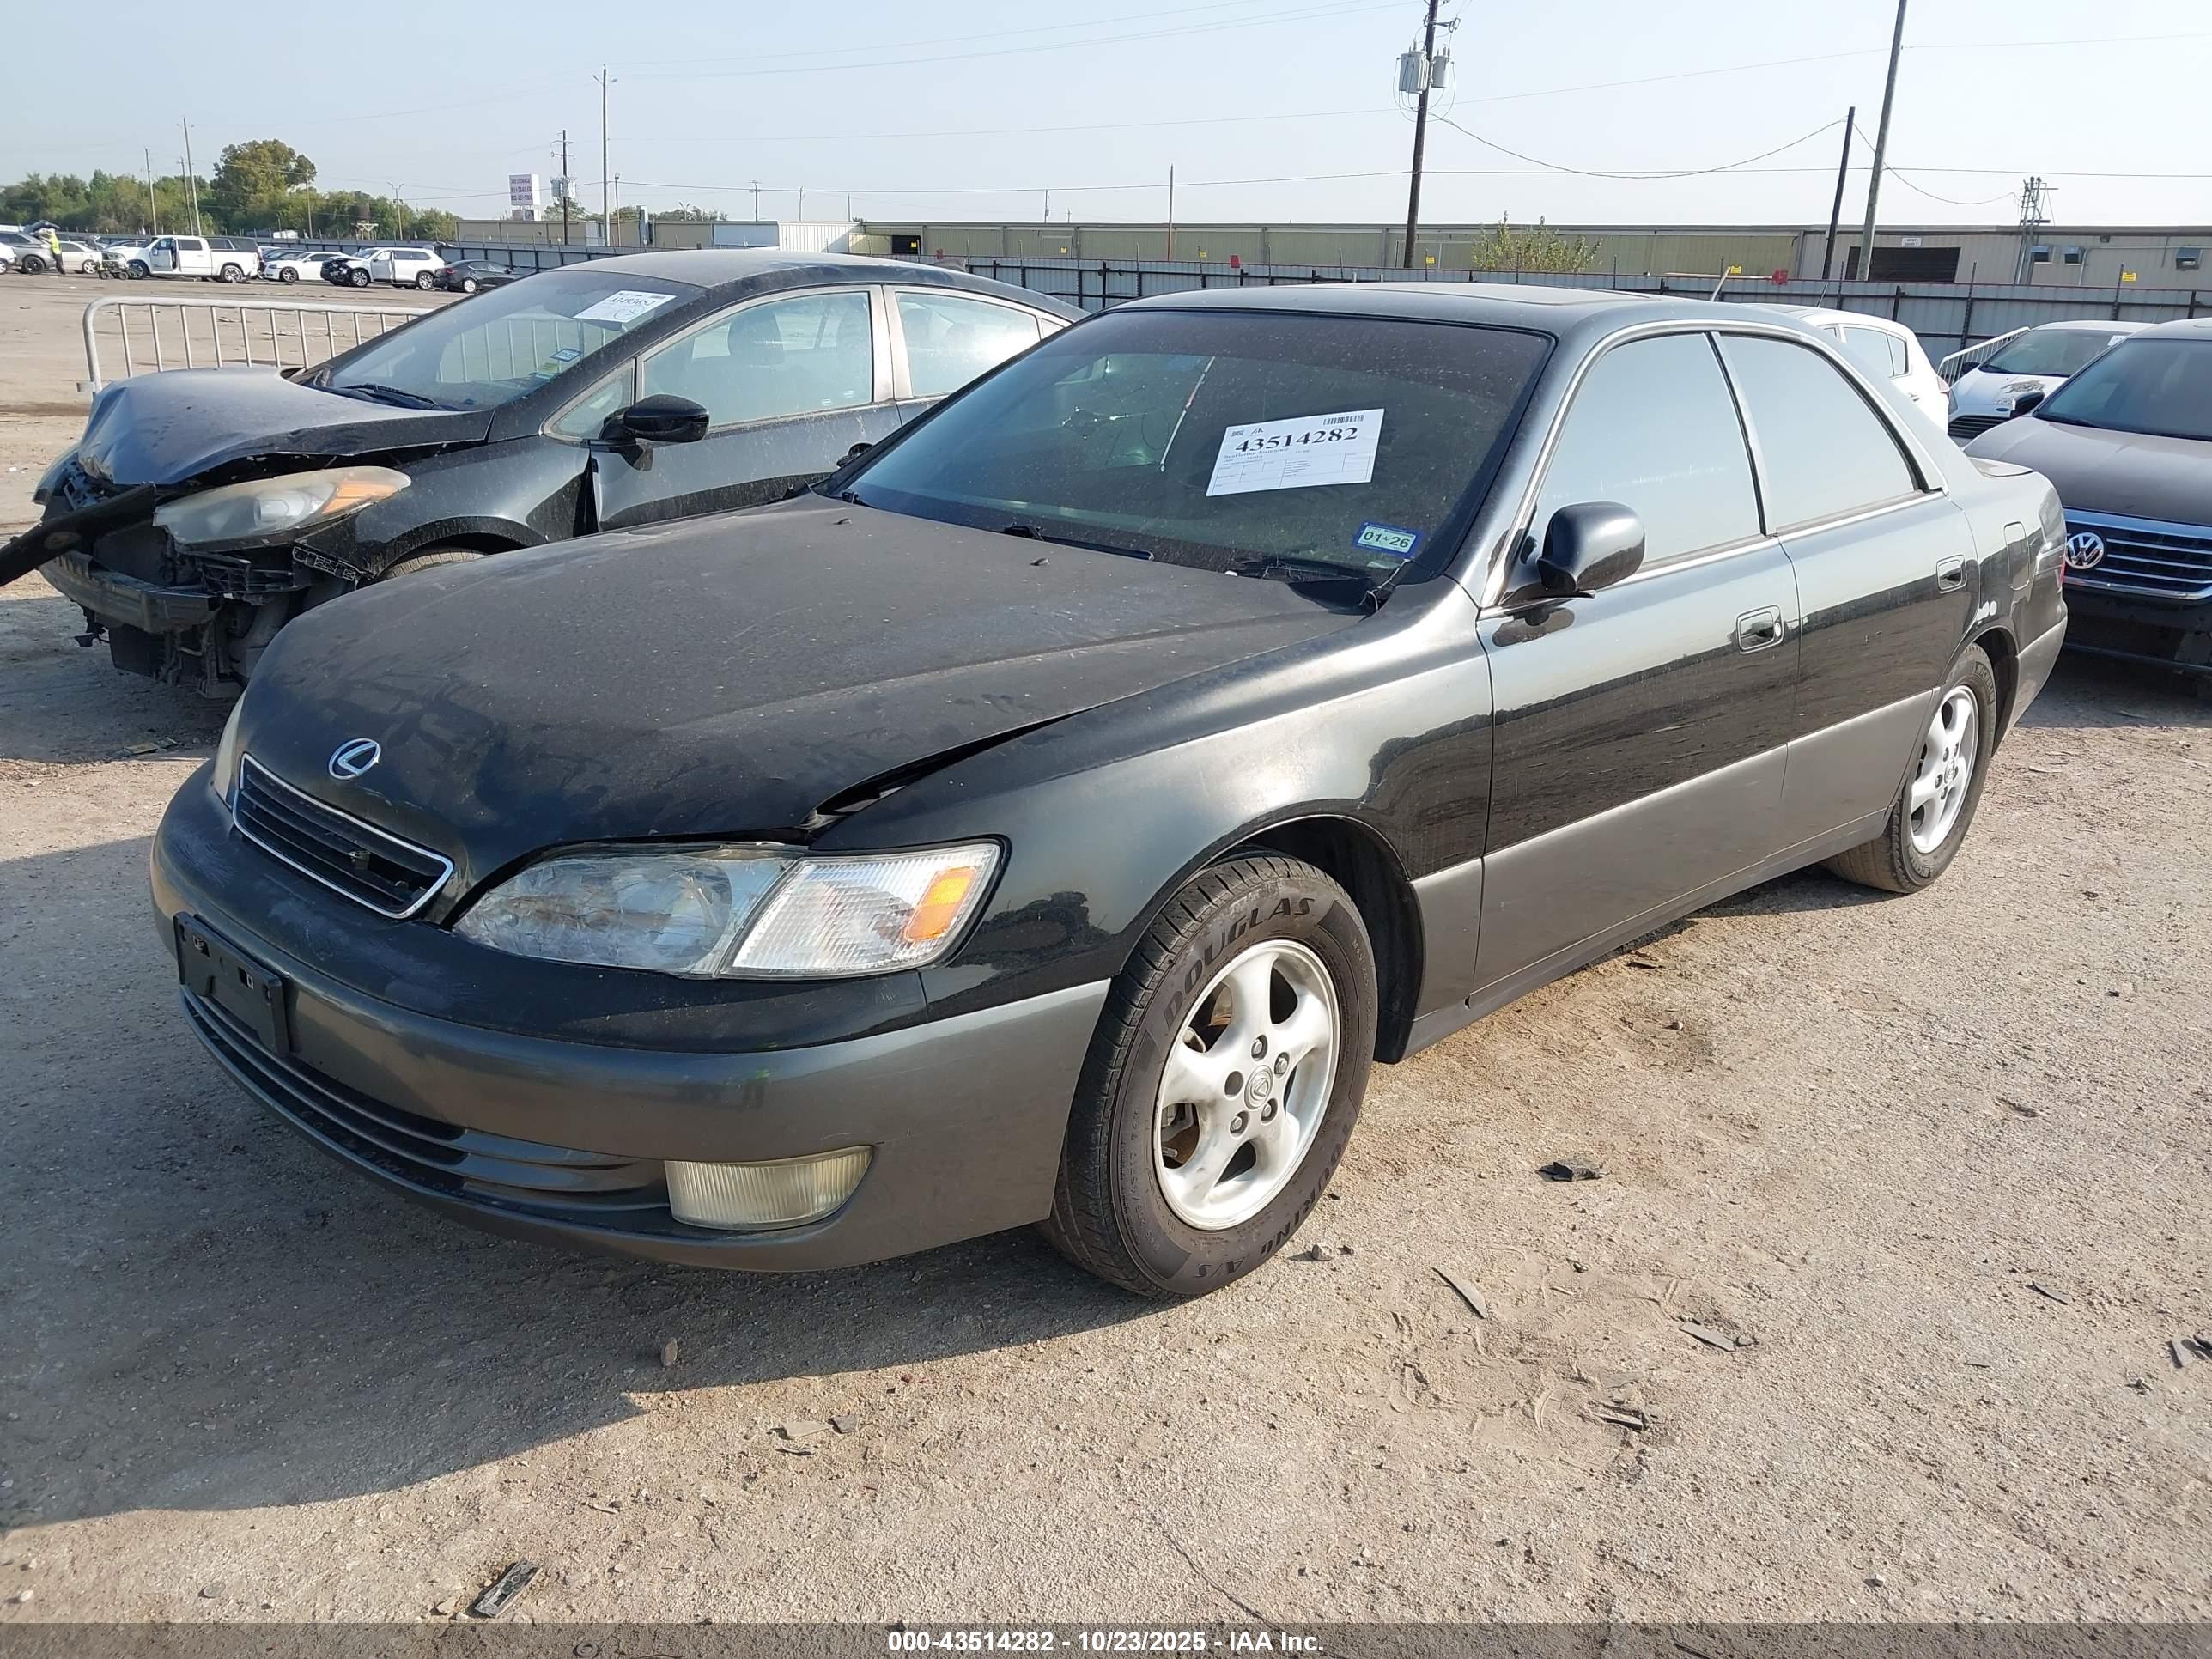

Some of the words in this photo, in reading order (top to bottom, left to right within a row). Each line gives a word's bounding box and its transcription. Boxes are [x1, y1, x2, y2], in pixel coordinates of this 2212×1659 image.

[1235, 427, 1358, 453] 43514282
[1363, 531, 1382, 543] 01
[1389, 536, 1410, 548] 26
[1164, 897, 1316, 1030] DOUGLAS
[1194, 1256, 1246, 1279] A/S
